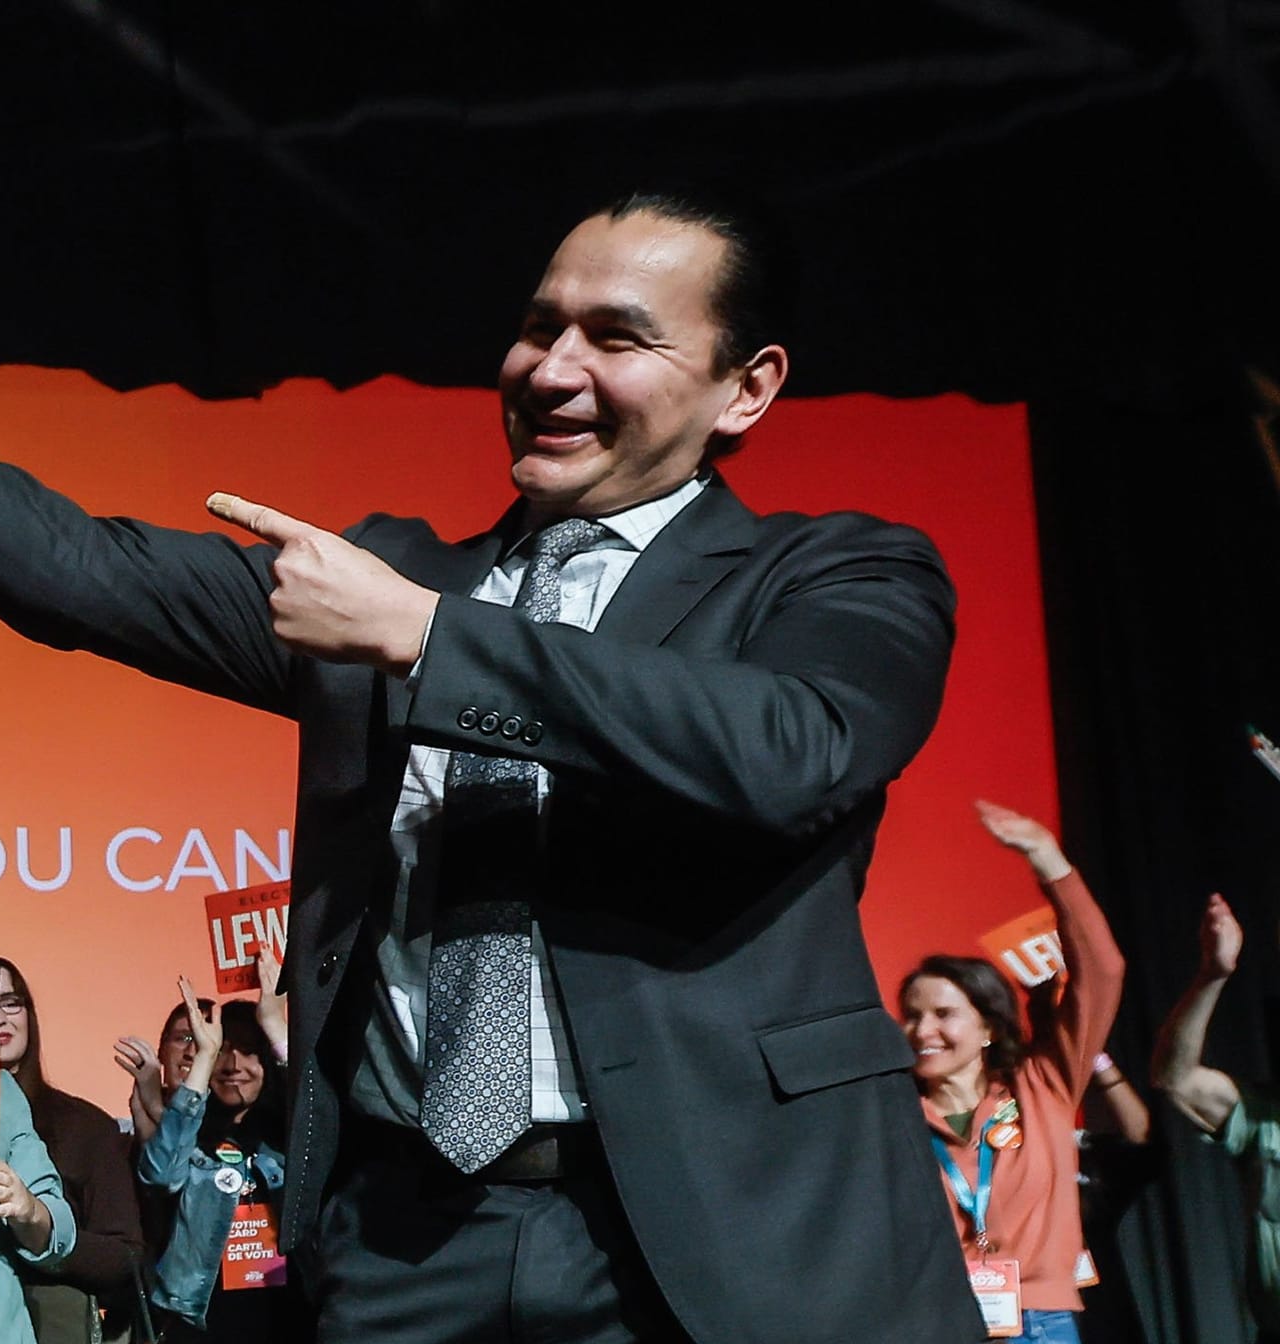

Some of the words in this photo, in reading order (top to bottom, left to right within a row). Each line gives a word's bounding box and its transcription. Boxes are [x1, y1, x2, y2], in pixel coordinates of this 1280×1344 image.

[1001, 929, 1067, 988] LE
[228, 1242, 263, 1252] CARTE
[228, 1252, 243, 1261] DE
[244, 1250, 274, 1260] VOTE
